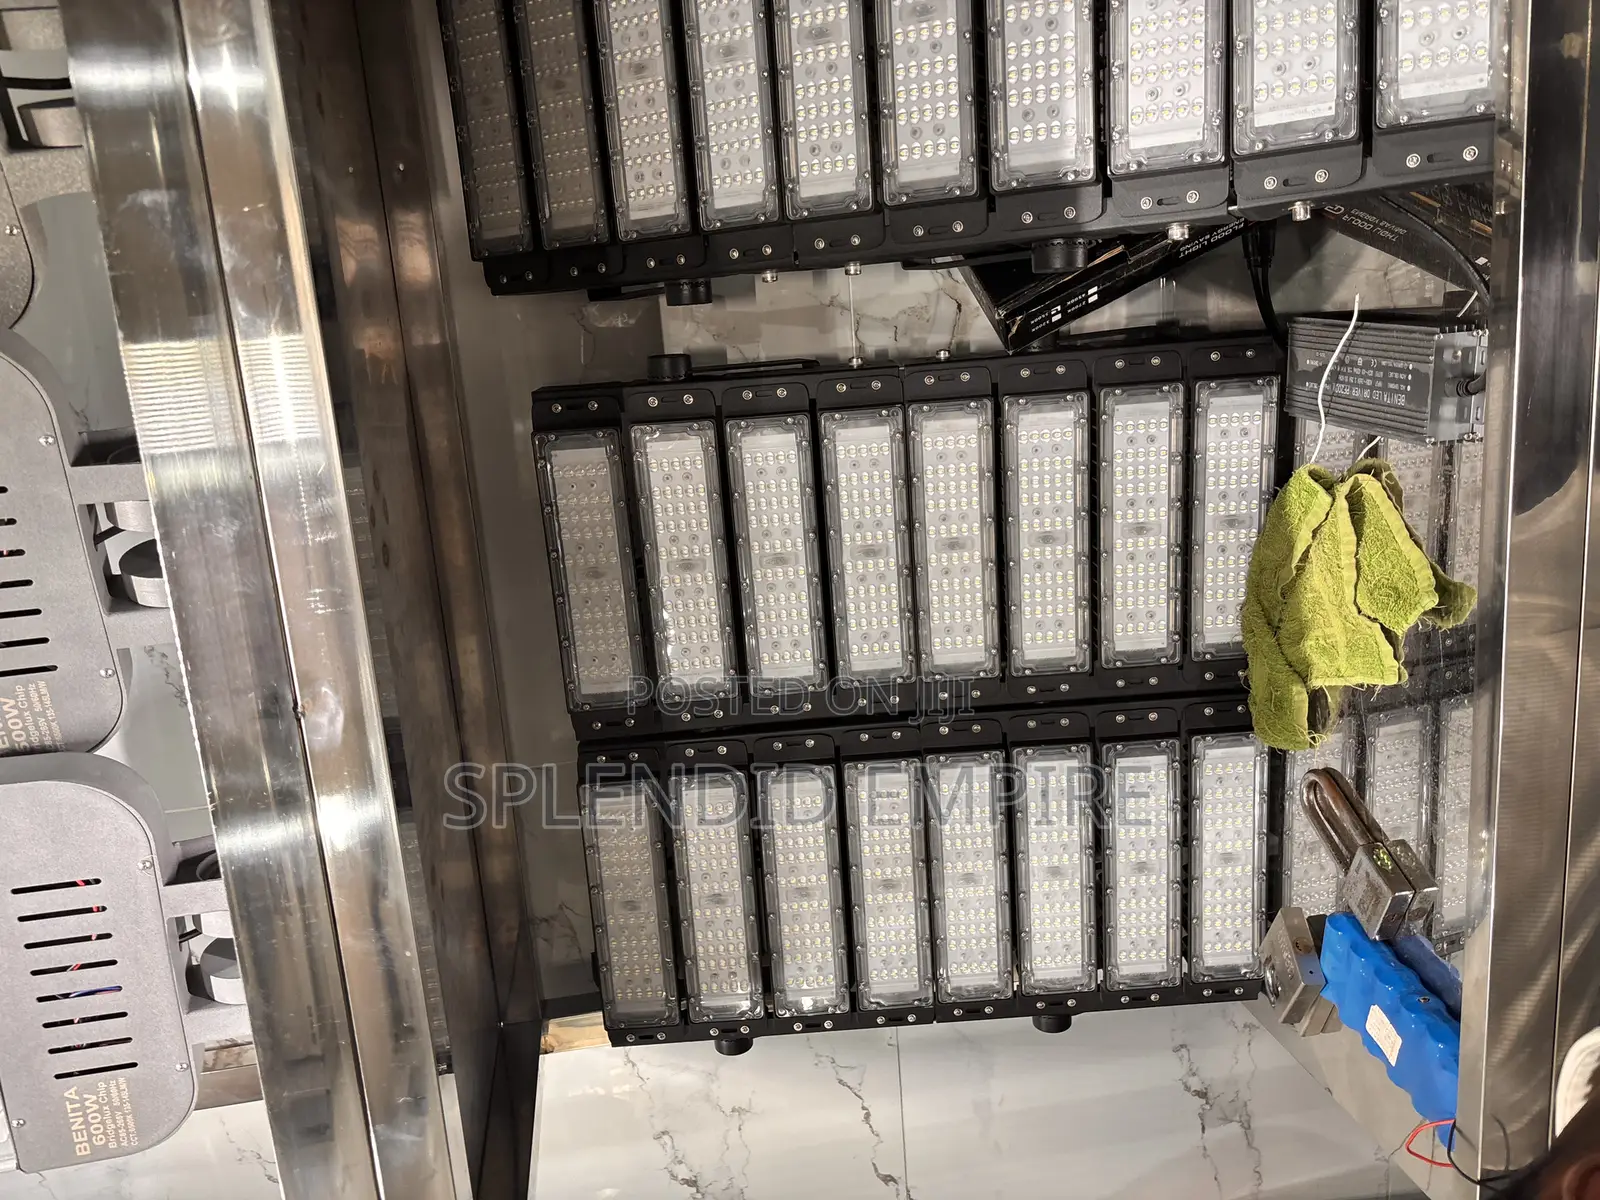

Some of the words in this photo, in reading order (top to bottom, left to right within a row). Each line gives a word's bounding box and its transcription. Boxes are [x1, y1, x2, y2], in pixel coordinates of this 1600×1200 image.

[1211, 222, 1244, 242] FLOOD
[1212, 217, 1245, 236] ENERGY
[1179, 240, 1207, 258] LIGHT
[15, 685, 28, 709] Chip
[97, 1081, 108, 1104] Chip
[64, 1086, 92, 1156] BENITA
[83, 1094, 106, 1146] 600W
[102, 1105, 117, 1149] Bridgelux
